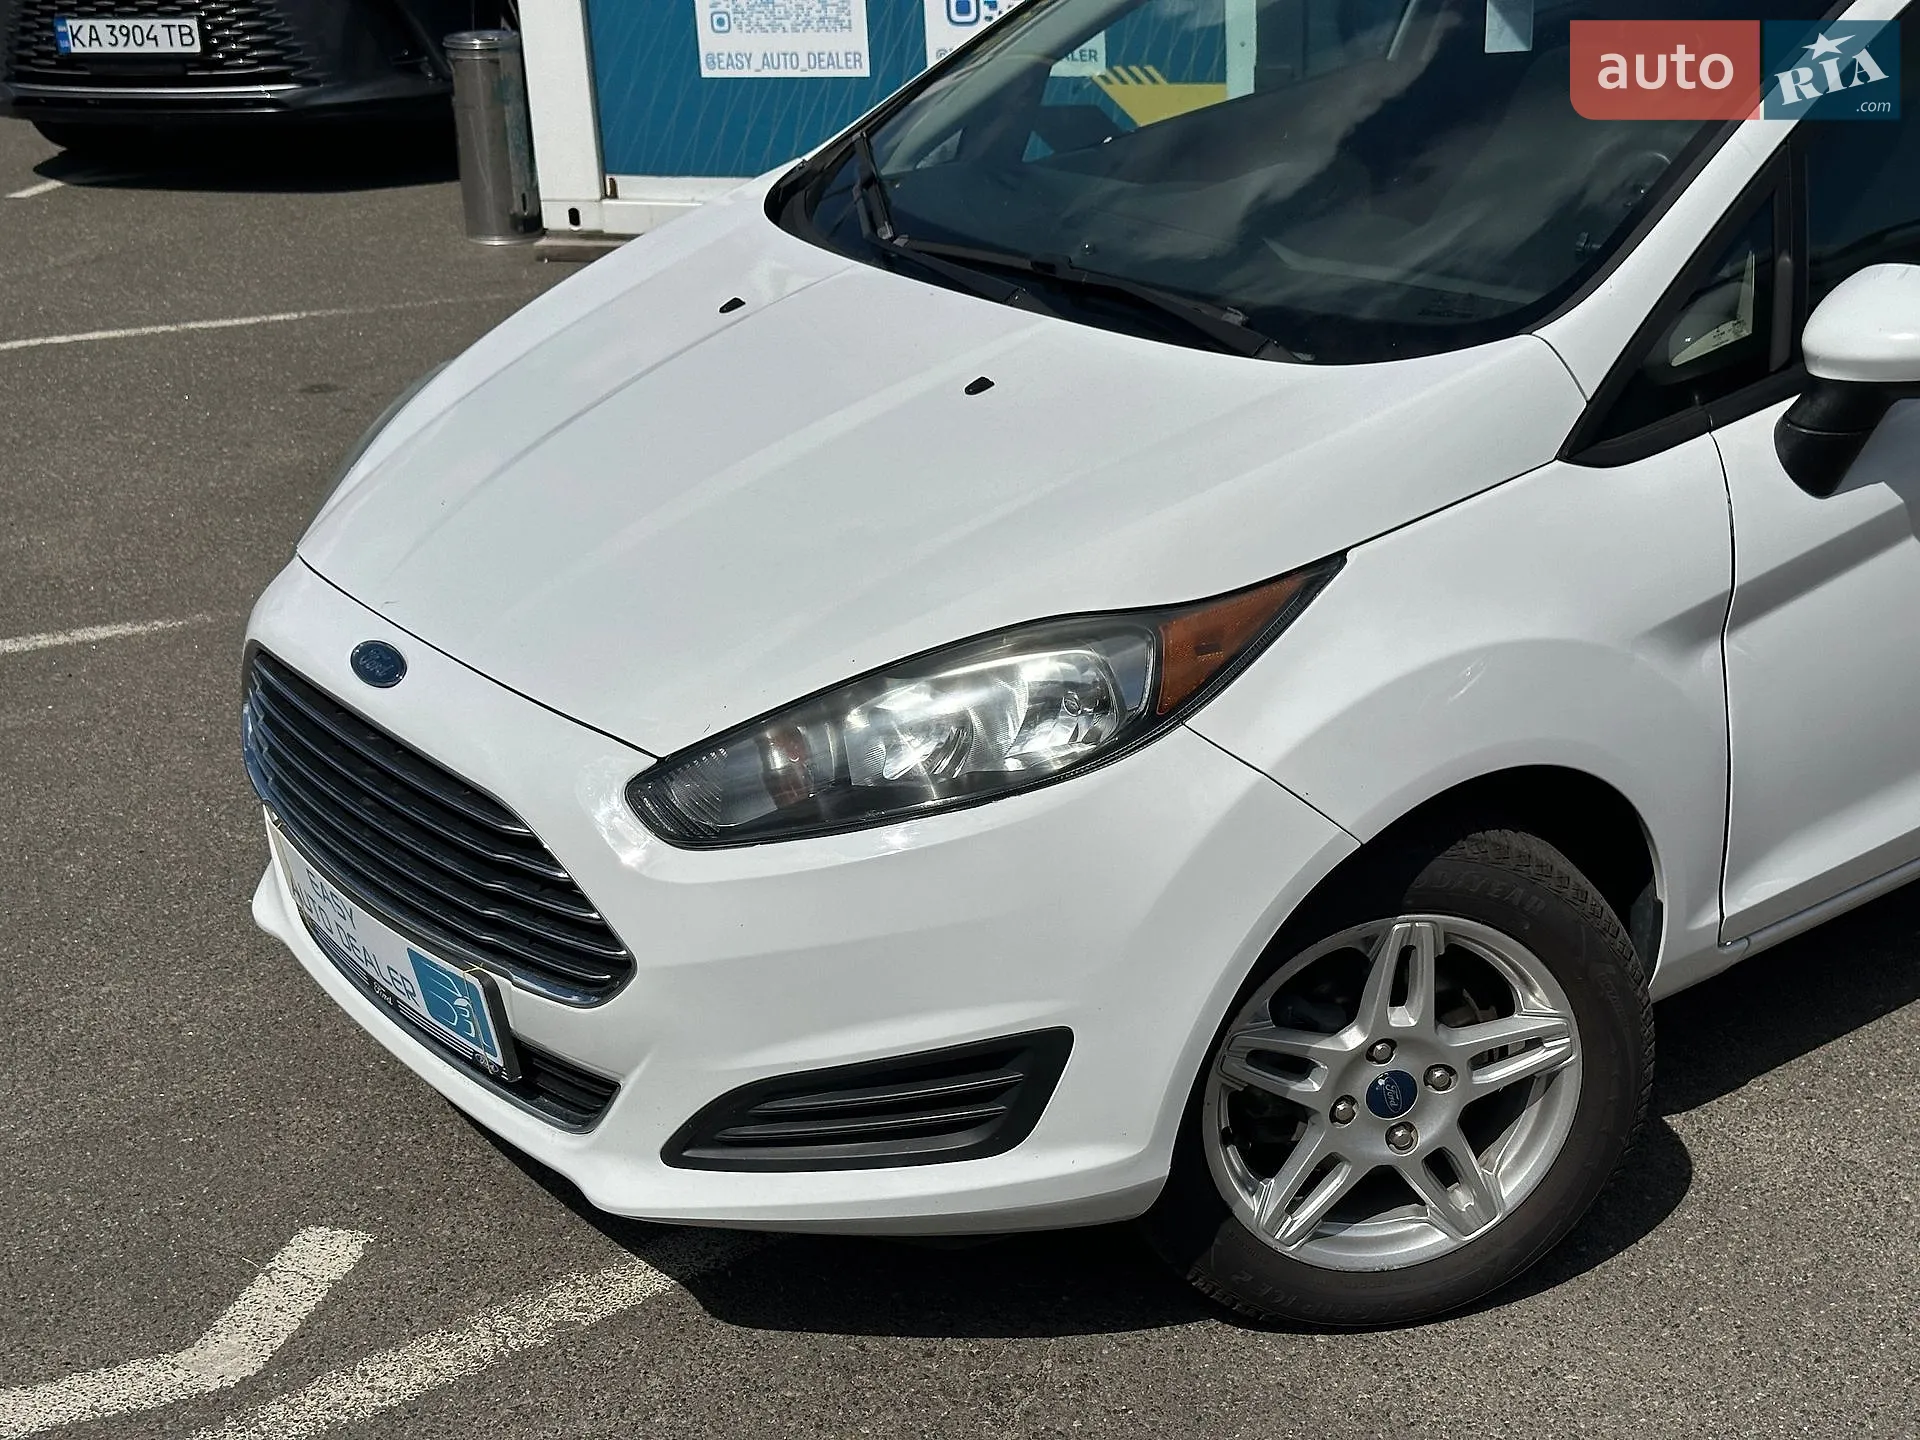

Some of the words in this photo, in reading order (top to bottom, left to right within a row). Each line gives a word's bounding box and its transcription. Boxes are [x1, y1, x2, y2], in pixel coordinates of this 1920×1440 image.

[69, 24, 103, 48] KA
[105, 24, 159, 48] 3904
[161, 24, 195, 48] TB
[705, 52, 863, 72] @EASY_AUTO_DEALER
[305, 868, 357, 930] EASY
[291, 881, 334, 935] AUTO
[334, 919, 421, 1007] DEALER
